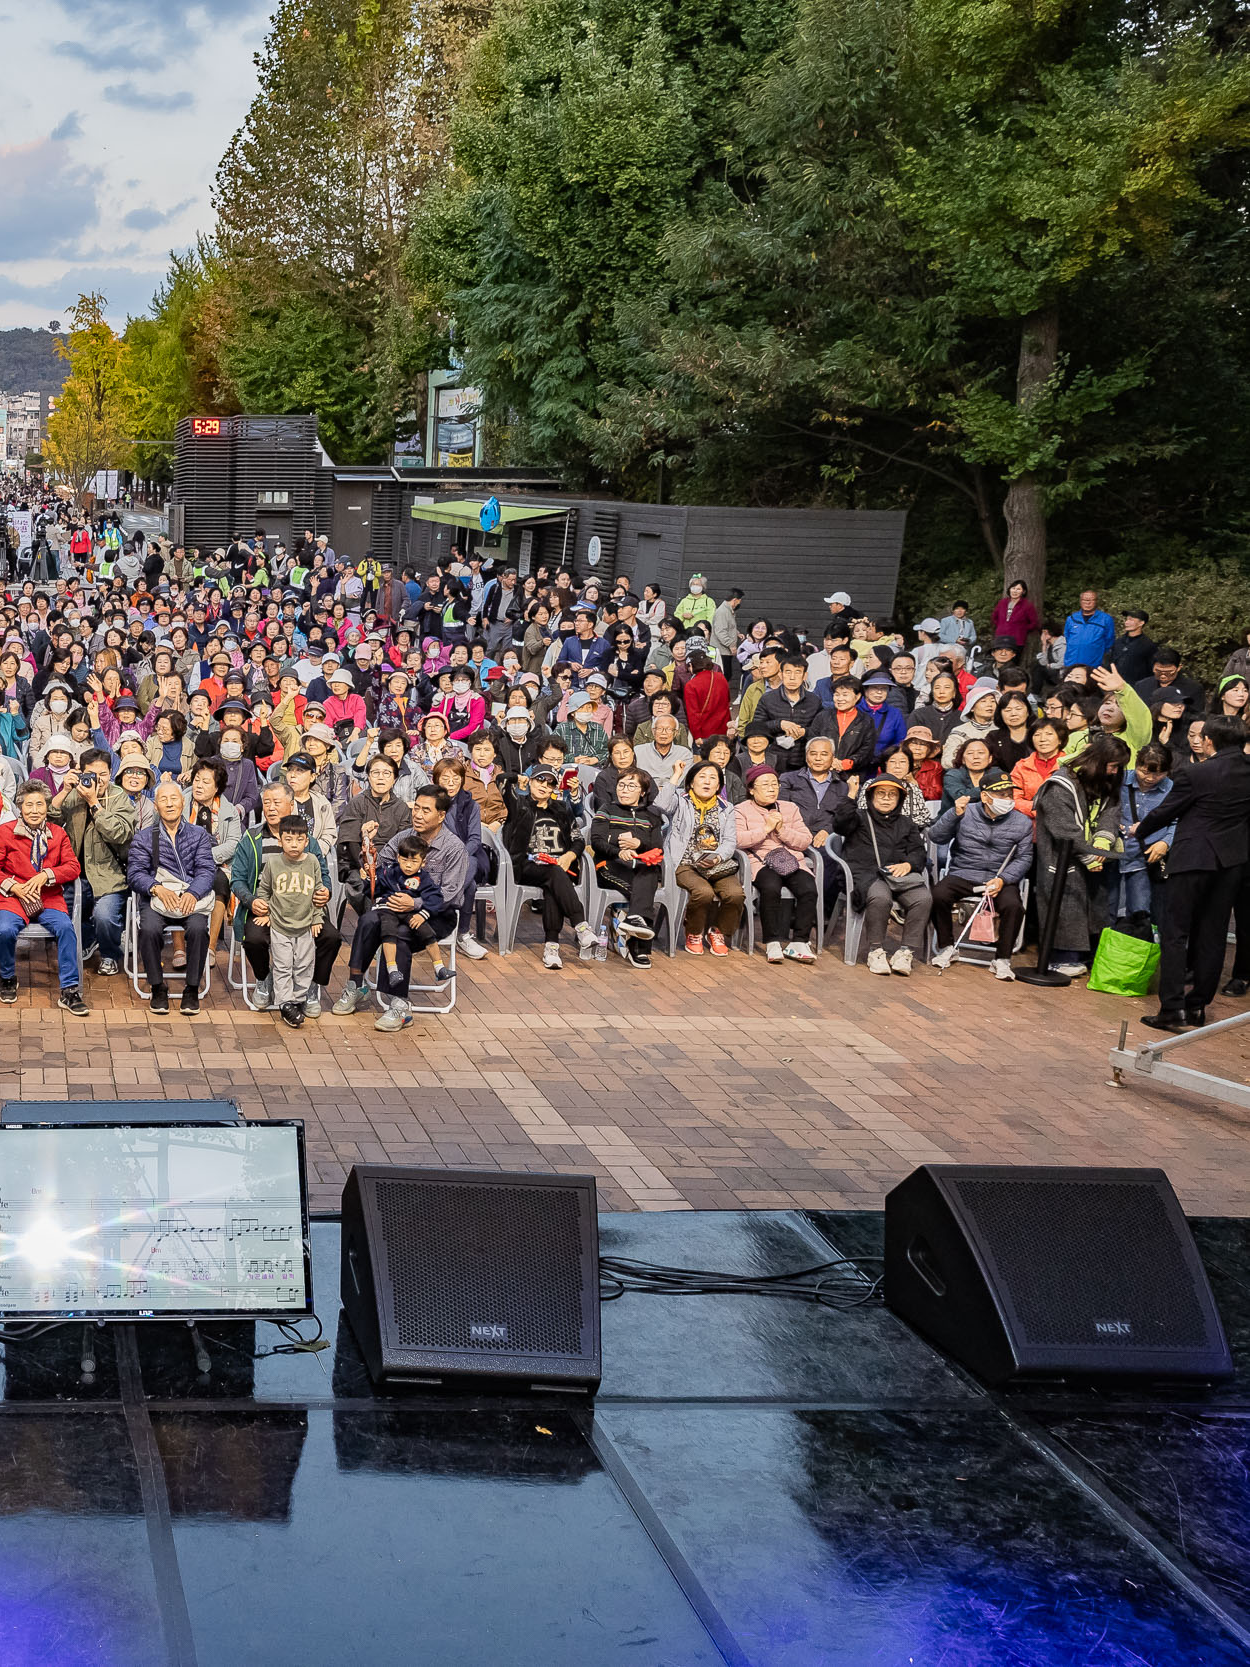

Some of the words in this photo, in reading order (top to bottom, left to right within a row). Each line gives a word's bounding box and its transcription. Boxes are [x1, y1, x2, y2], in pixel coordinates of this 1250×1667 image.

[194, 419, 220, 434] 5:29
[275, 871, 316, 896] GAP
[471, 1324, 507, 1339] NEXT
[1095, 1321, 1131, 1335] NEXT
